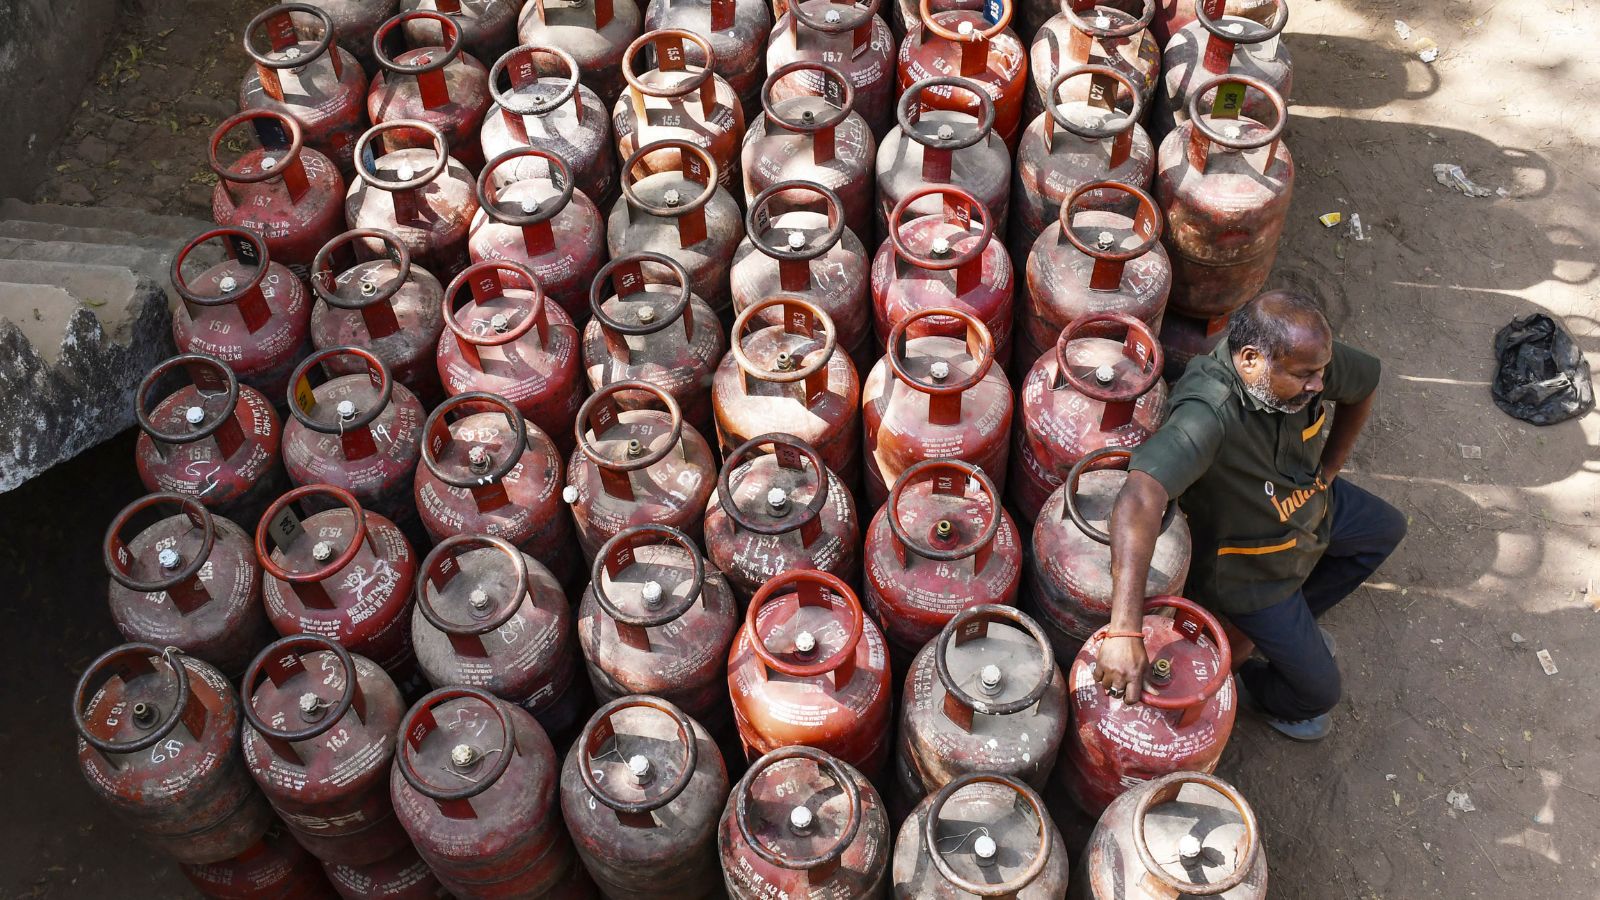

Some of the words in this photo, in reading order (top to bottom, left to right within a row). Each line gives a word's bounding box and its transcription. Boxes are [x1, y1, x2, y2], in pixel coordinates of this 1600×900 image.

[667, 47, 681, 61] 15.5
[821, 51, 844, 63] 15.7
[1103, 52, 1124, 67] 15.8
[910, 60, 927, 76] NETT
[932, 57, 953, 75] 15.6
[1090, 84, 1105, 101] C27
[662, 115, 681, 126] 15.5
[720, 116, 736, 134] 1906
[251, 194, 272, 208] 15.7
[189, 335, 207, 349] NETT
[449, 376, 467, 393] 1906
[253, 417, 263, 435] NETT
[629, 424, 654, 436] 15.4
[653, 463, 676, 485] 15.4
[318, 526, 344, 538] 15.8
[999, 522, 1016, 547] GROSS
[870, 563, 886, 589] 1906
[345, 597, 368, 620] NETT
[350, 602, 377, 627] GROSS
[1191, 660, 1209, 682] 16.7
[736, 676, 750, 697] 1906
[326, 728, 350, 752] 16.2
[774, 779, 801, 798] 15.9
